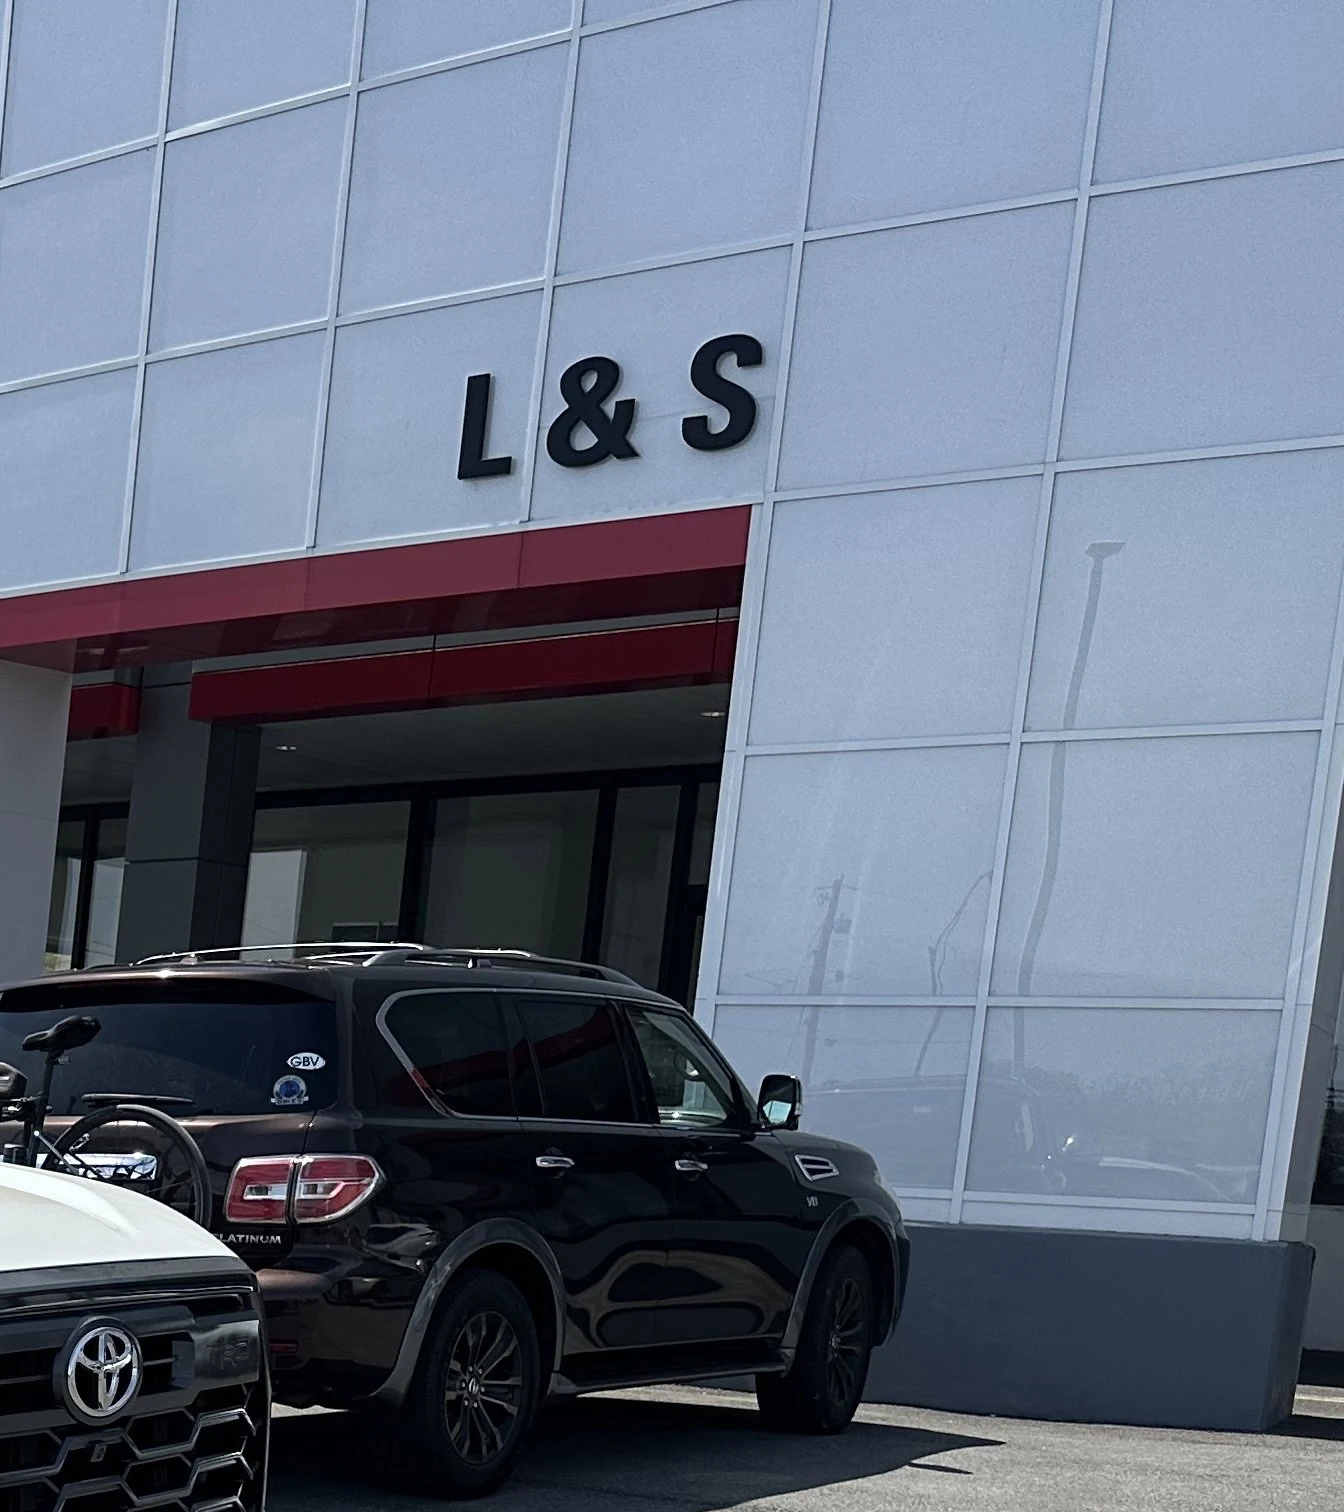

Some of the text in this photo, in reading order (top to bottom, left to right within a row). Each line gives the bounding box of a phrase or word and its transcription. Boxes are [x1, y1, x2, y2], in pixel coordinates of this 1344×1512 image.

[457, 333, 763, 480] L & S
[290, 1056, 320, 1068] GBV
